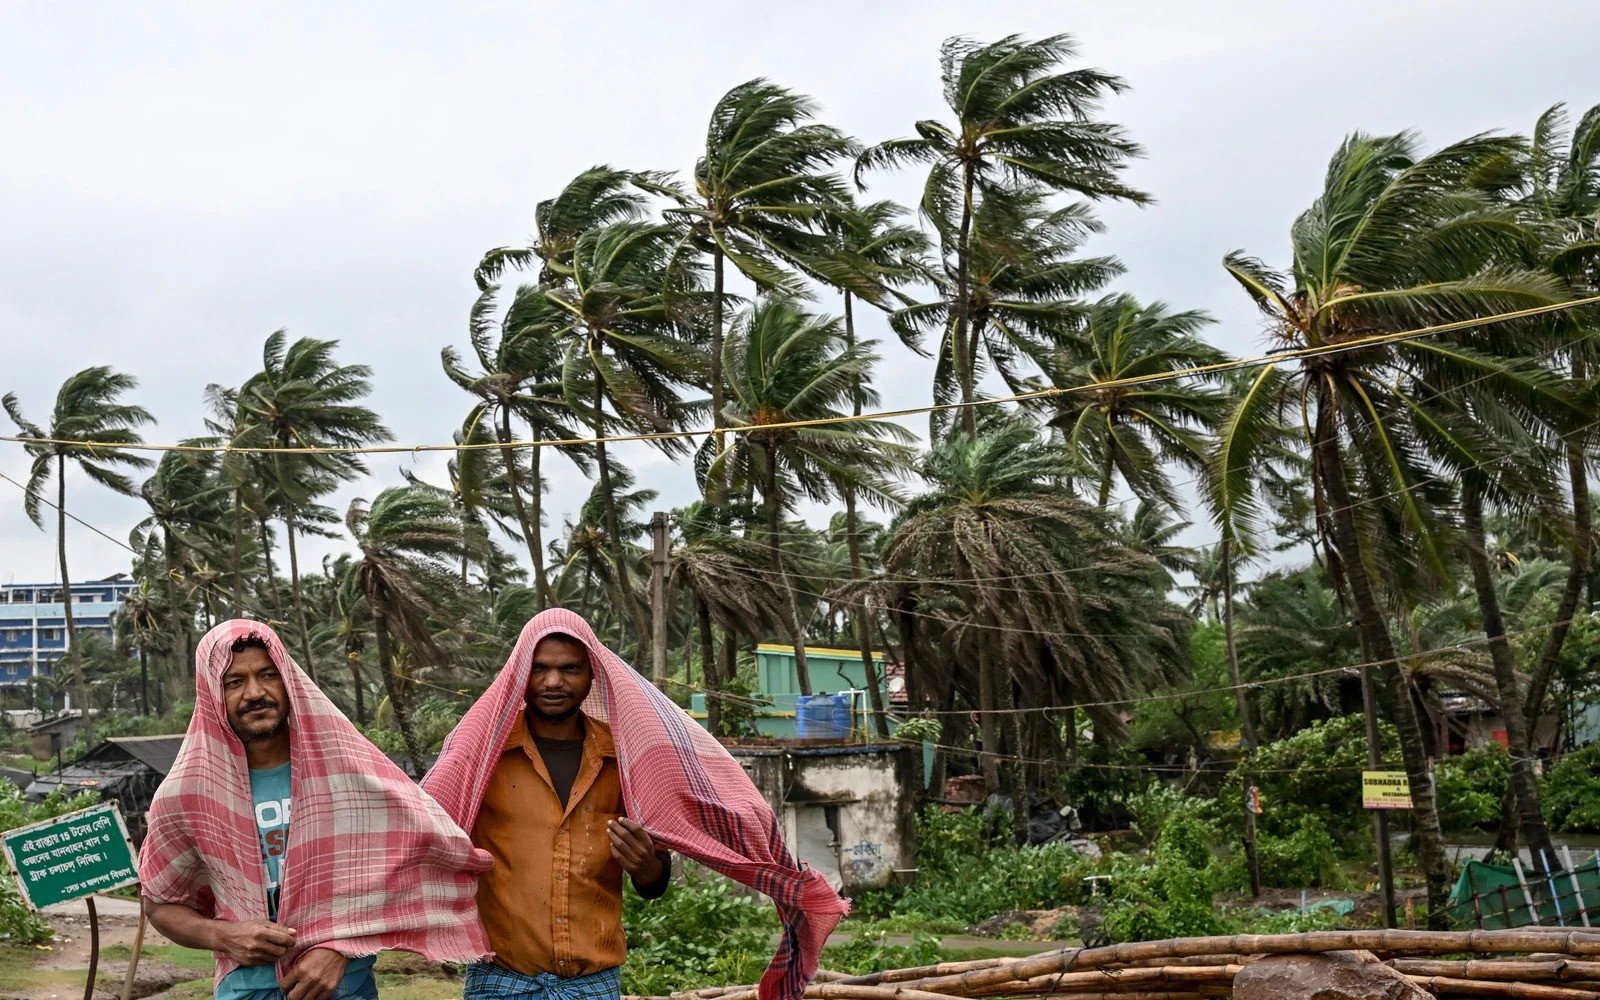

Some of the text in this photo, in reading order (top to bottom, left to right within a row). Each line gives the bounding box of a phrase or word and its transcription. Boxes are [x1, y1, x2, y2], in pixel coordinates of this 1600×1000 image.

[22, 841, 37, 852] এই
[59, 831, 71, 842] 15
[68, 824, 93, 837] টনের
[92, 816, 112, 831] বেশি
[102, 834, 110, 842] ও
